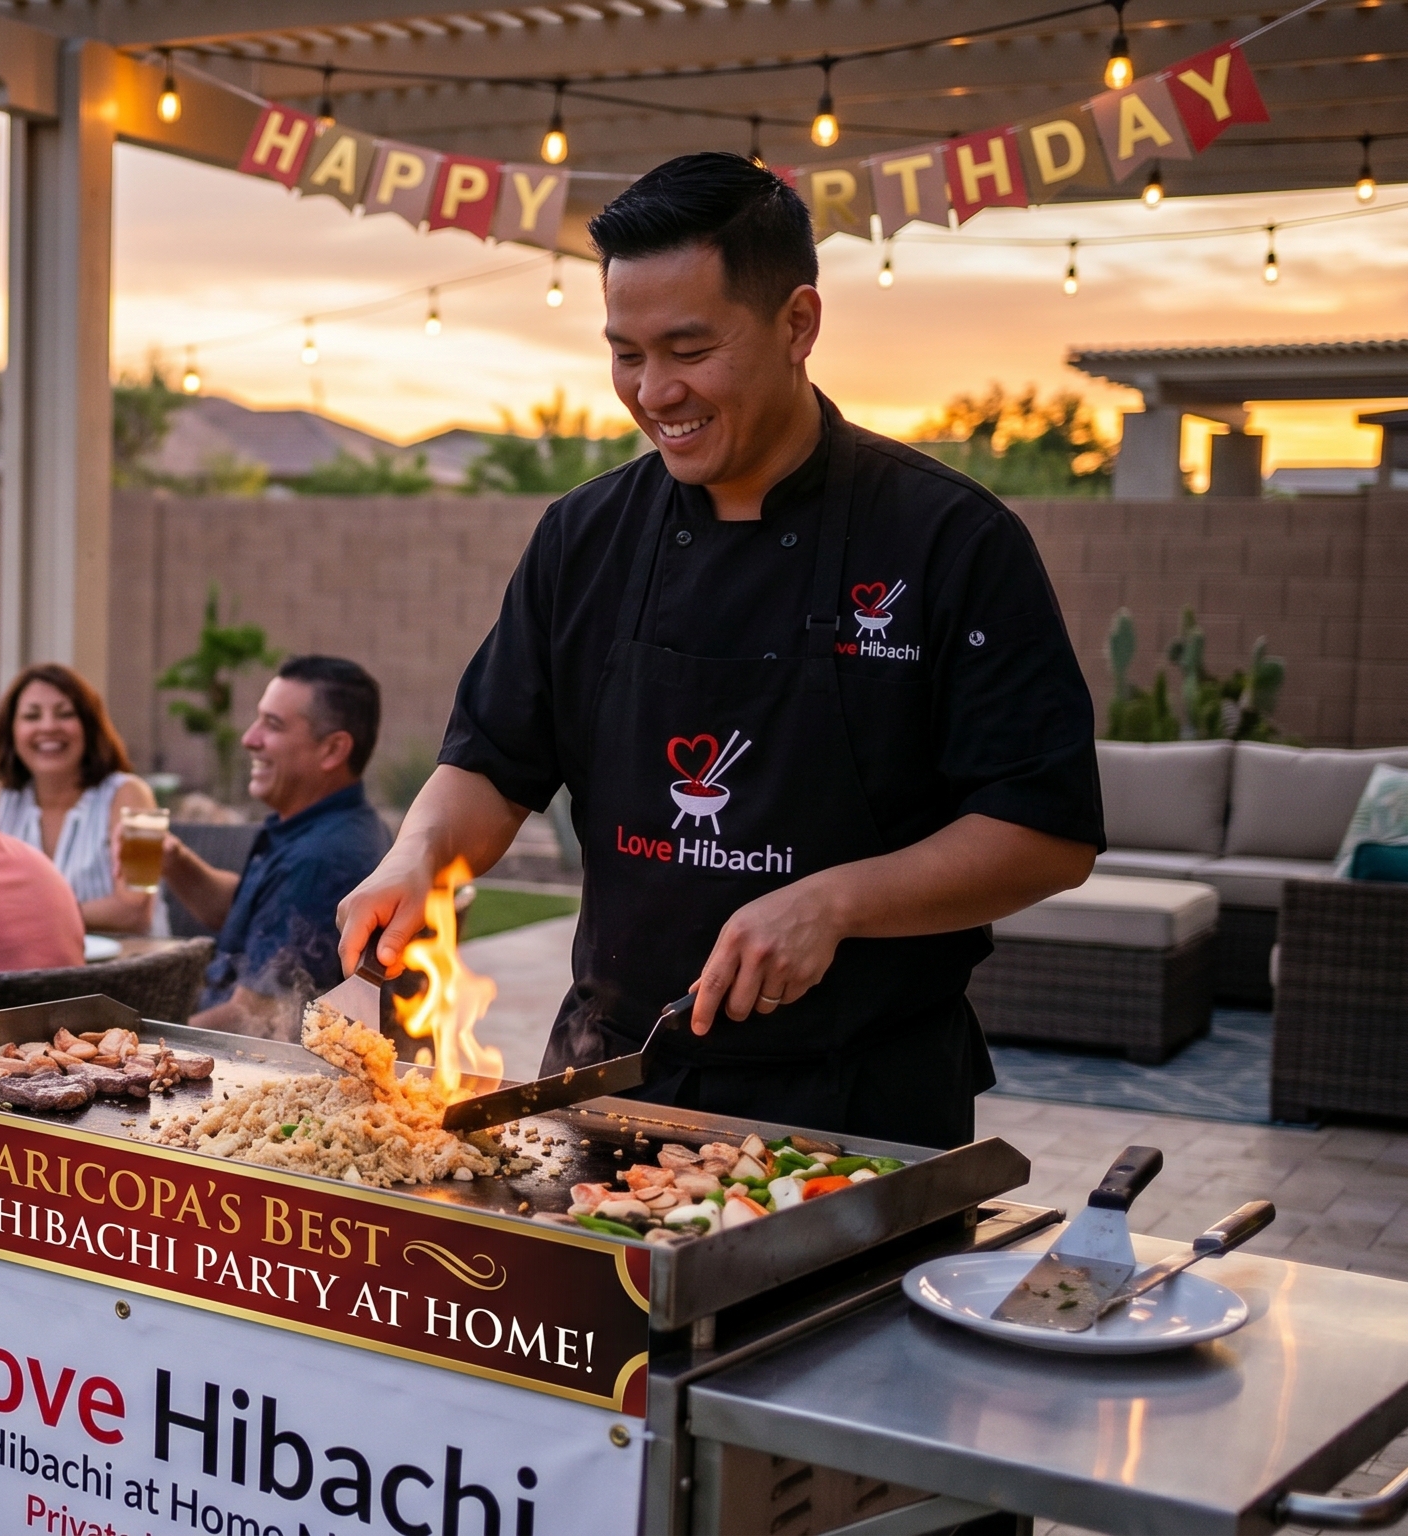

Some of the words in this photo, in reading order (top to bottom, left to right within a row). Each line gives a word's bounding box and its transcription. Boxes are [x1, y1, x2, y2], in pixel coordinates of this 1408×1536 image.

[252, 110, 559, 231] HAPPY
[810, 53, 1232, 229] RTHDAY
[834, 642, 858, 655] ve
[860, 640, 920, 661] Hibachi
[617, 826, 673, 861] Love
[678, 838, 792, 873] Hibachi
[261, 1195, 390, 1267] BEST
[194, 1243, 340, 1311] PARTY
[347, 1281, 409, 1328] AT
[423, 1295, 594, 1374] HOME!
[154, 1369, 538, 1536] Hibachi
[124, 1478, 160, 1515] at
